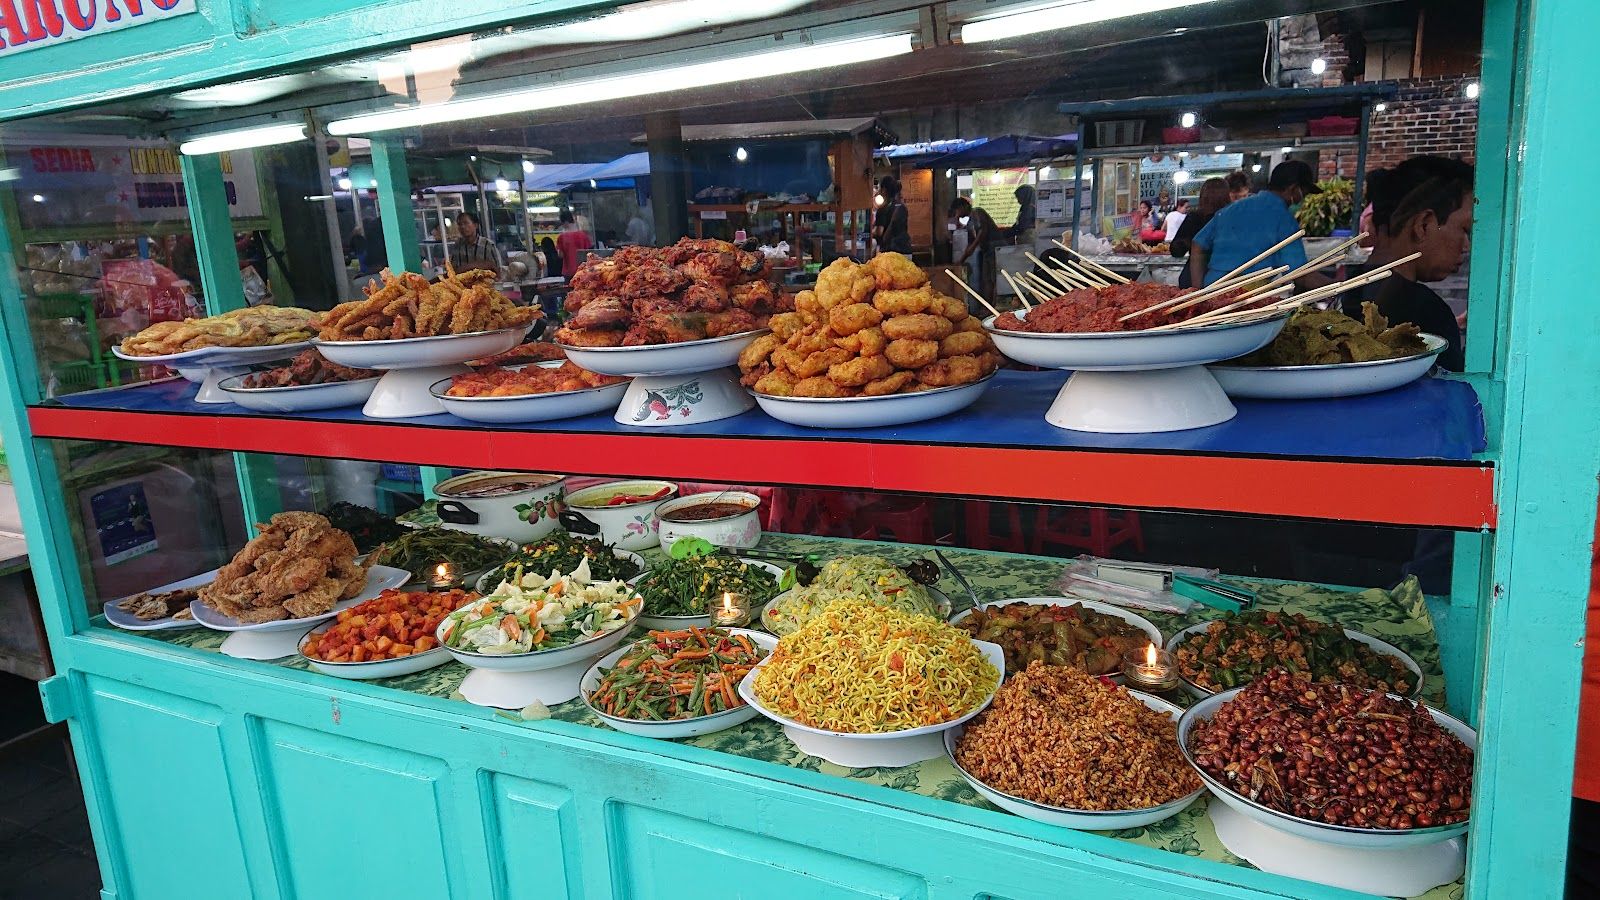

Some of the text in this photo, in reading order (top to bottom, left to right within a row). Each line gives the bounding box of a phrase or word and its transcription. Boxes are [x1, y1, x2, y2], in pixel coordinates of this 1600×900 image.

[0, 0, 180, 50] ARU
[31, 147, 95, 173] SEDIA
[129, 147, 183, 175] LONTON
[1140, 173, 1156, 181] ULE
[1140, 180, 1154, 189] ATE
[1140, 189, 1155, 198] OTO
